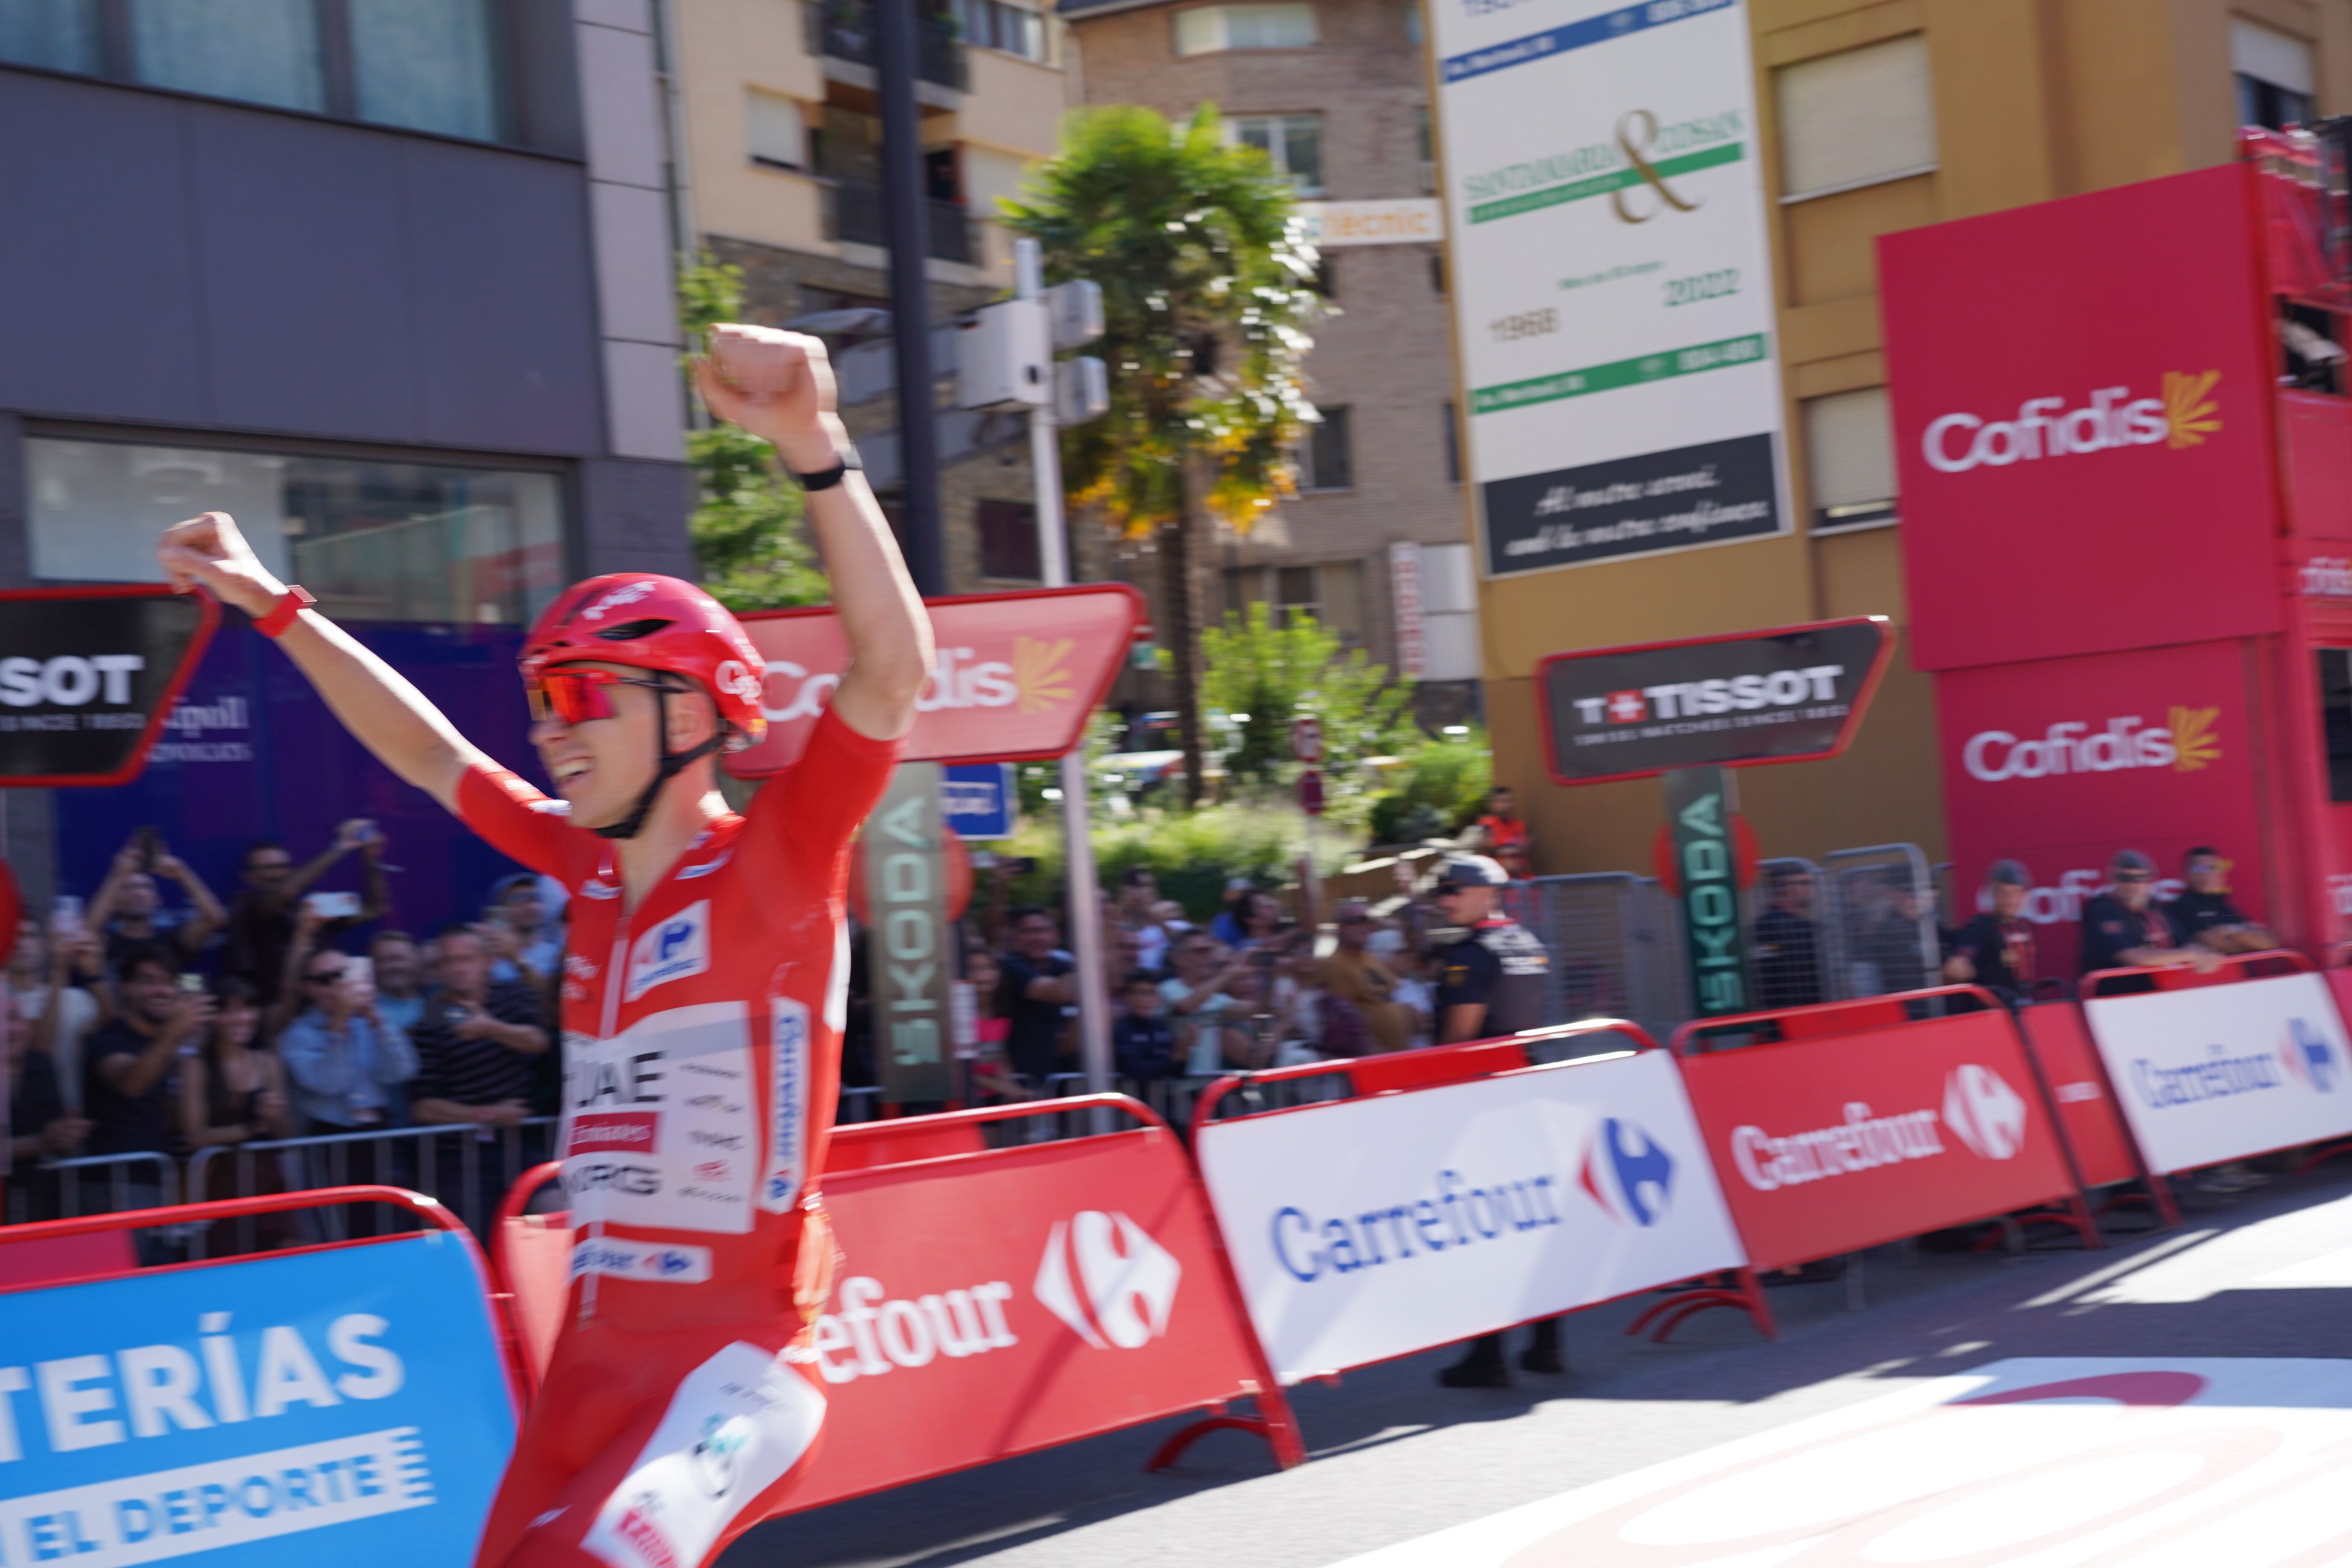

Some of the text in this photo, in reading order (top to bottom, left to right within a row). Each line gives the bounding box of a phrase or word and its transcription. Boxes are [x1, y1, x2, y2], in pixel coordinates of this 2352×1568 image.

[1922, 387, 2172, 473] Cofidis
[0, 654, 145, 706] SOT
[763, 648, 1018, 722] Codis
[1643, 663, 1844, 720] TISSOT
[1964, 715, 2179, 783] Cofidis
[1731, 1101, 1946, 1192] Carrefour
[1271, 1169, 1563, 1282] Carrefour
[814, 1275, 1018, 1384] efour
[22, 1511, 103, 1561] EL
[114, 1453, 388, 1545] DEPORTE
